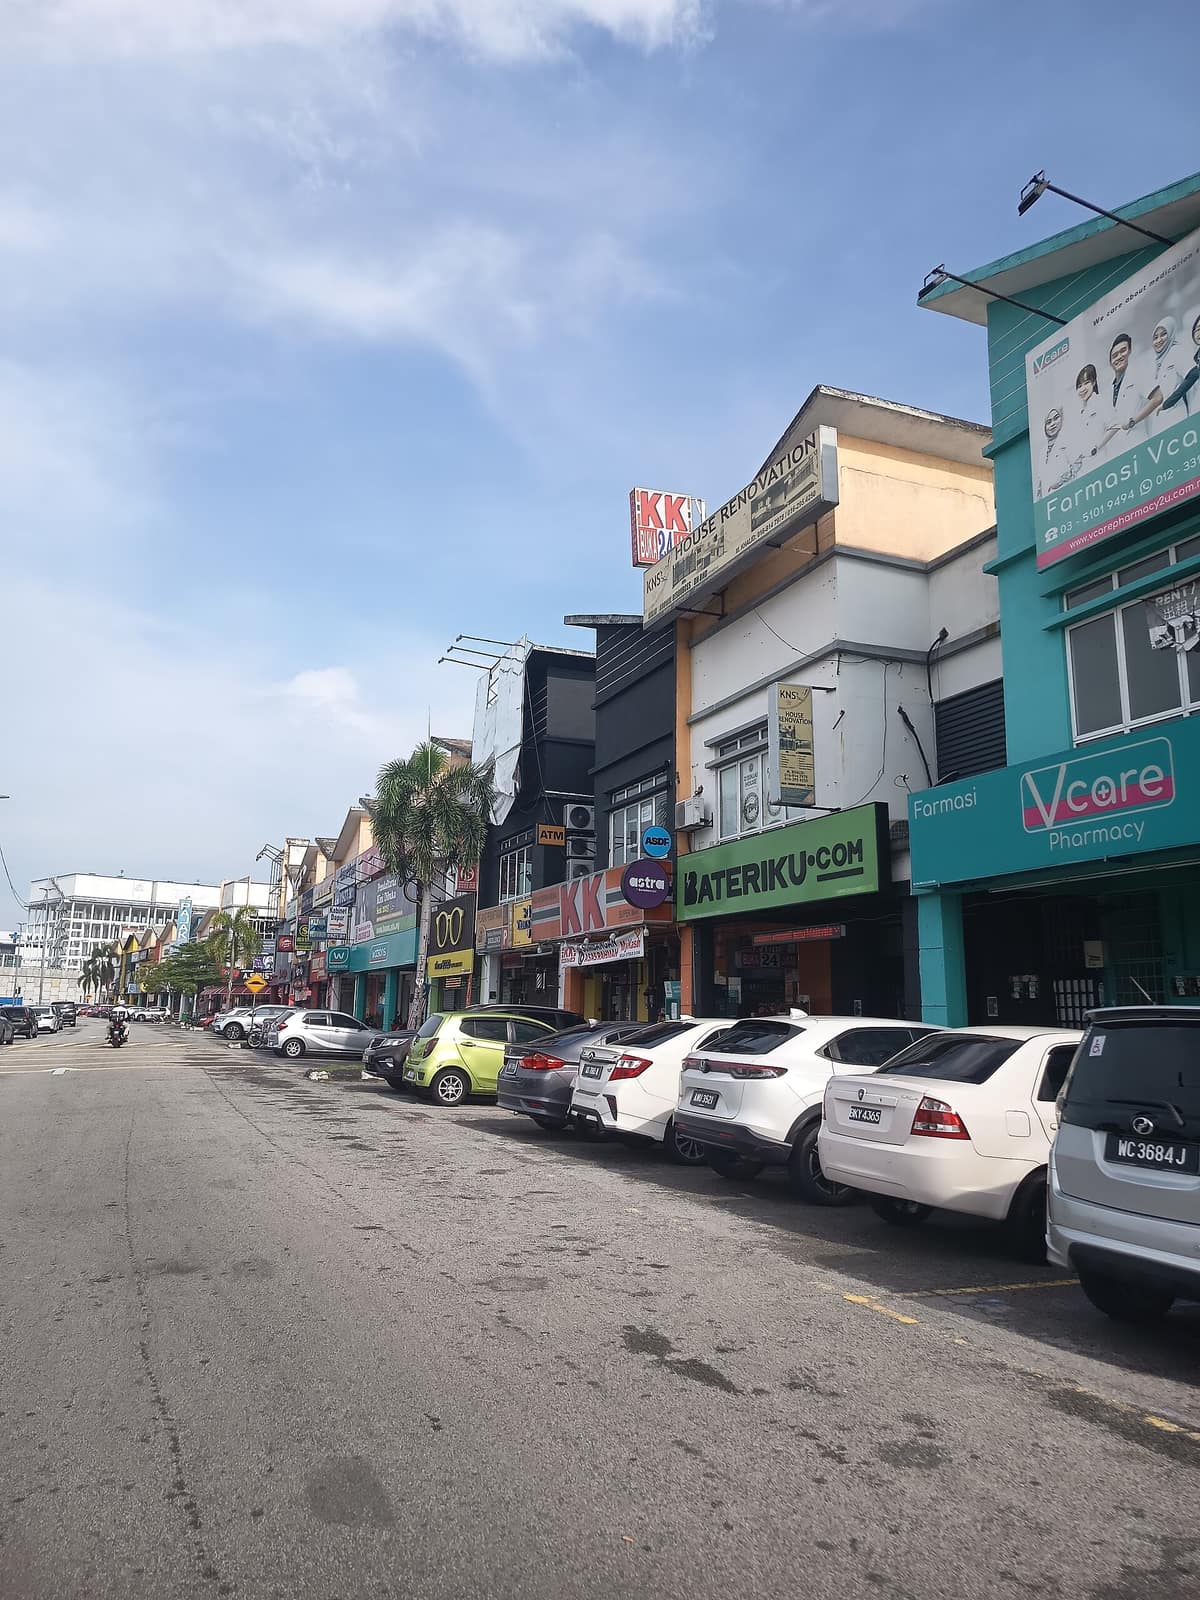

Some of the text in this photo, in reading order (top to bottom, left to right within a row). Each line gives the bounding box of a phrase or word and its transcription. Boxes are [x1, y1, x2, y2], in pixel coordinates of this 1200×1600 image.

[1092, 316, 1105, 327] We
[1106, 303, 1123, 317] care
[1125, 285, 1147, 304] about
[1033, 342, 1070, 373] Vcare
[674, 433, 817, 560] HOUSE RENOVATION
[1046, 454, 1138, 521] Farmasi
[1060, 521, 1073, 535] 03
[1082, 506, 1105, 522] 5101
[1106, 490, 1135, 510] 9494
[1156, 469, 1175, 485] 012
[640, 490, 688, 532] KK
[646, 571, 661, 594] KNS
[1155, 585, 1188, 607] RENT
[780, 689, 797, 700] KNS
[778, 716, 812, 725] RENOVATION
[785, 711, 804, 719] HOUSE
[914, 786, 977, 819] Farmasi
[1023, 763, 1164, 829] Vcare
[540, 831, 564, 841] ATM
[645, 836, 670, 846] ASDF
[1050, 821, 1145, 850] Pharmacy
[629, 876, 665, 890] astra
[560, 874, 605, 936] KK
[180, 902, 191, 940] PAJAK
[333, 952, 345, 960] W
